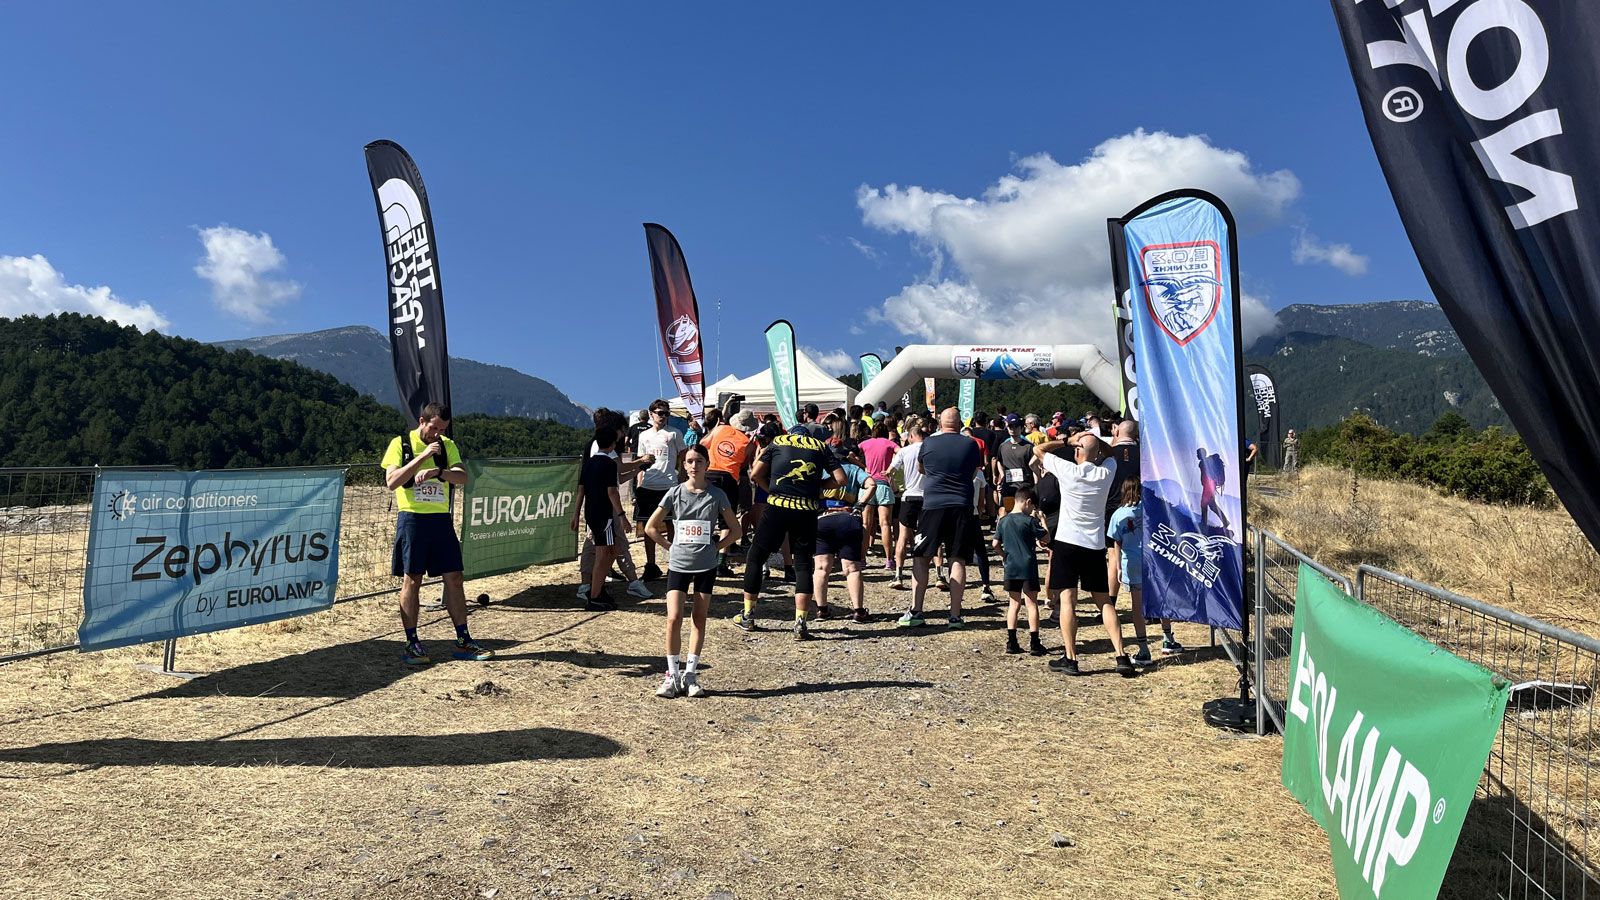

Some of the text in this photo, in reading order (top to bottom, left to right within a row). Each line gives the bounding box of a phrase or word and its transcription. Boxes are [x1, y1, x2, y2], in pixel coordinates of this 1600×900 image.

[141, 492, 258, 511] air conditioners
[470, 491, 572, 527] EUROLAMP
[685, 525, 702, 536] 598
[131, 531, 330, 586] Zephyrus
[195, 580, 323, 617] by EUROLAMP
[1289, 631, 1431, 899] EOLAMP
